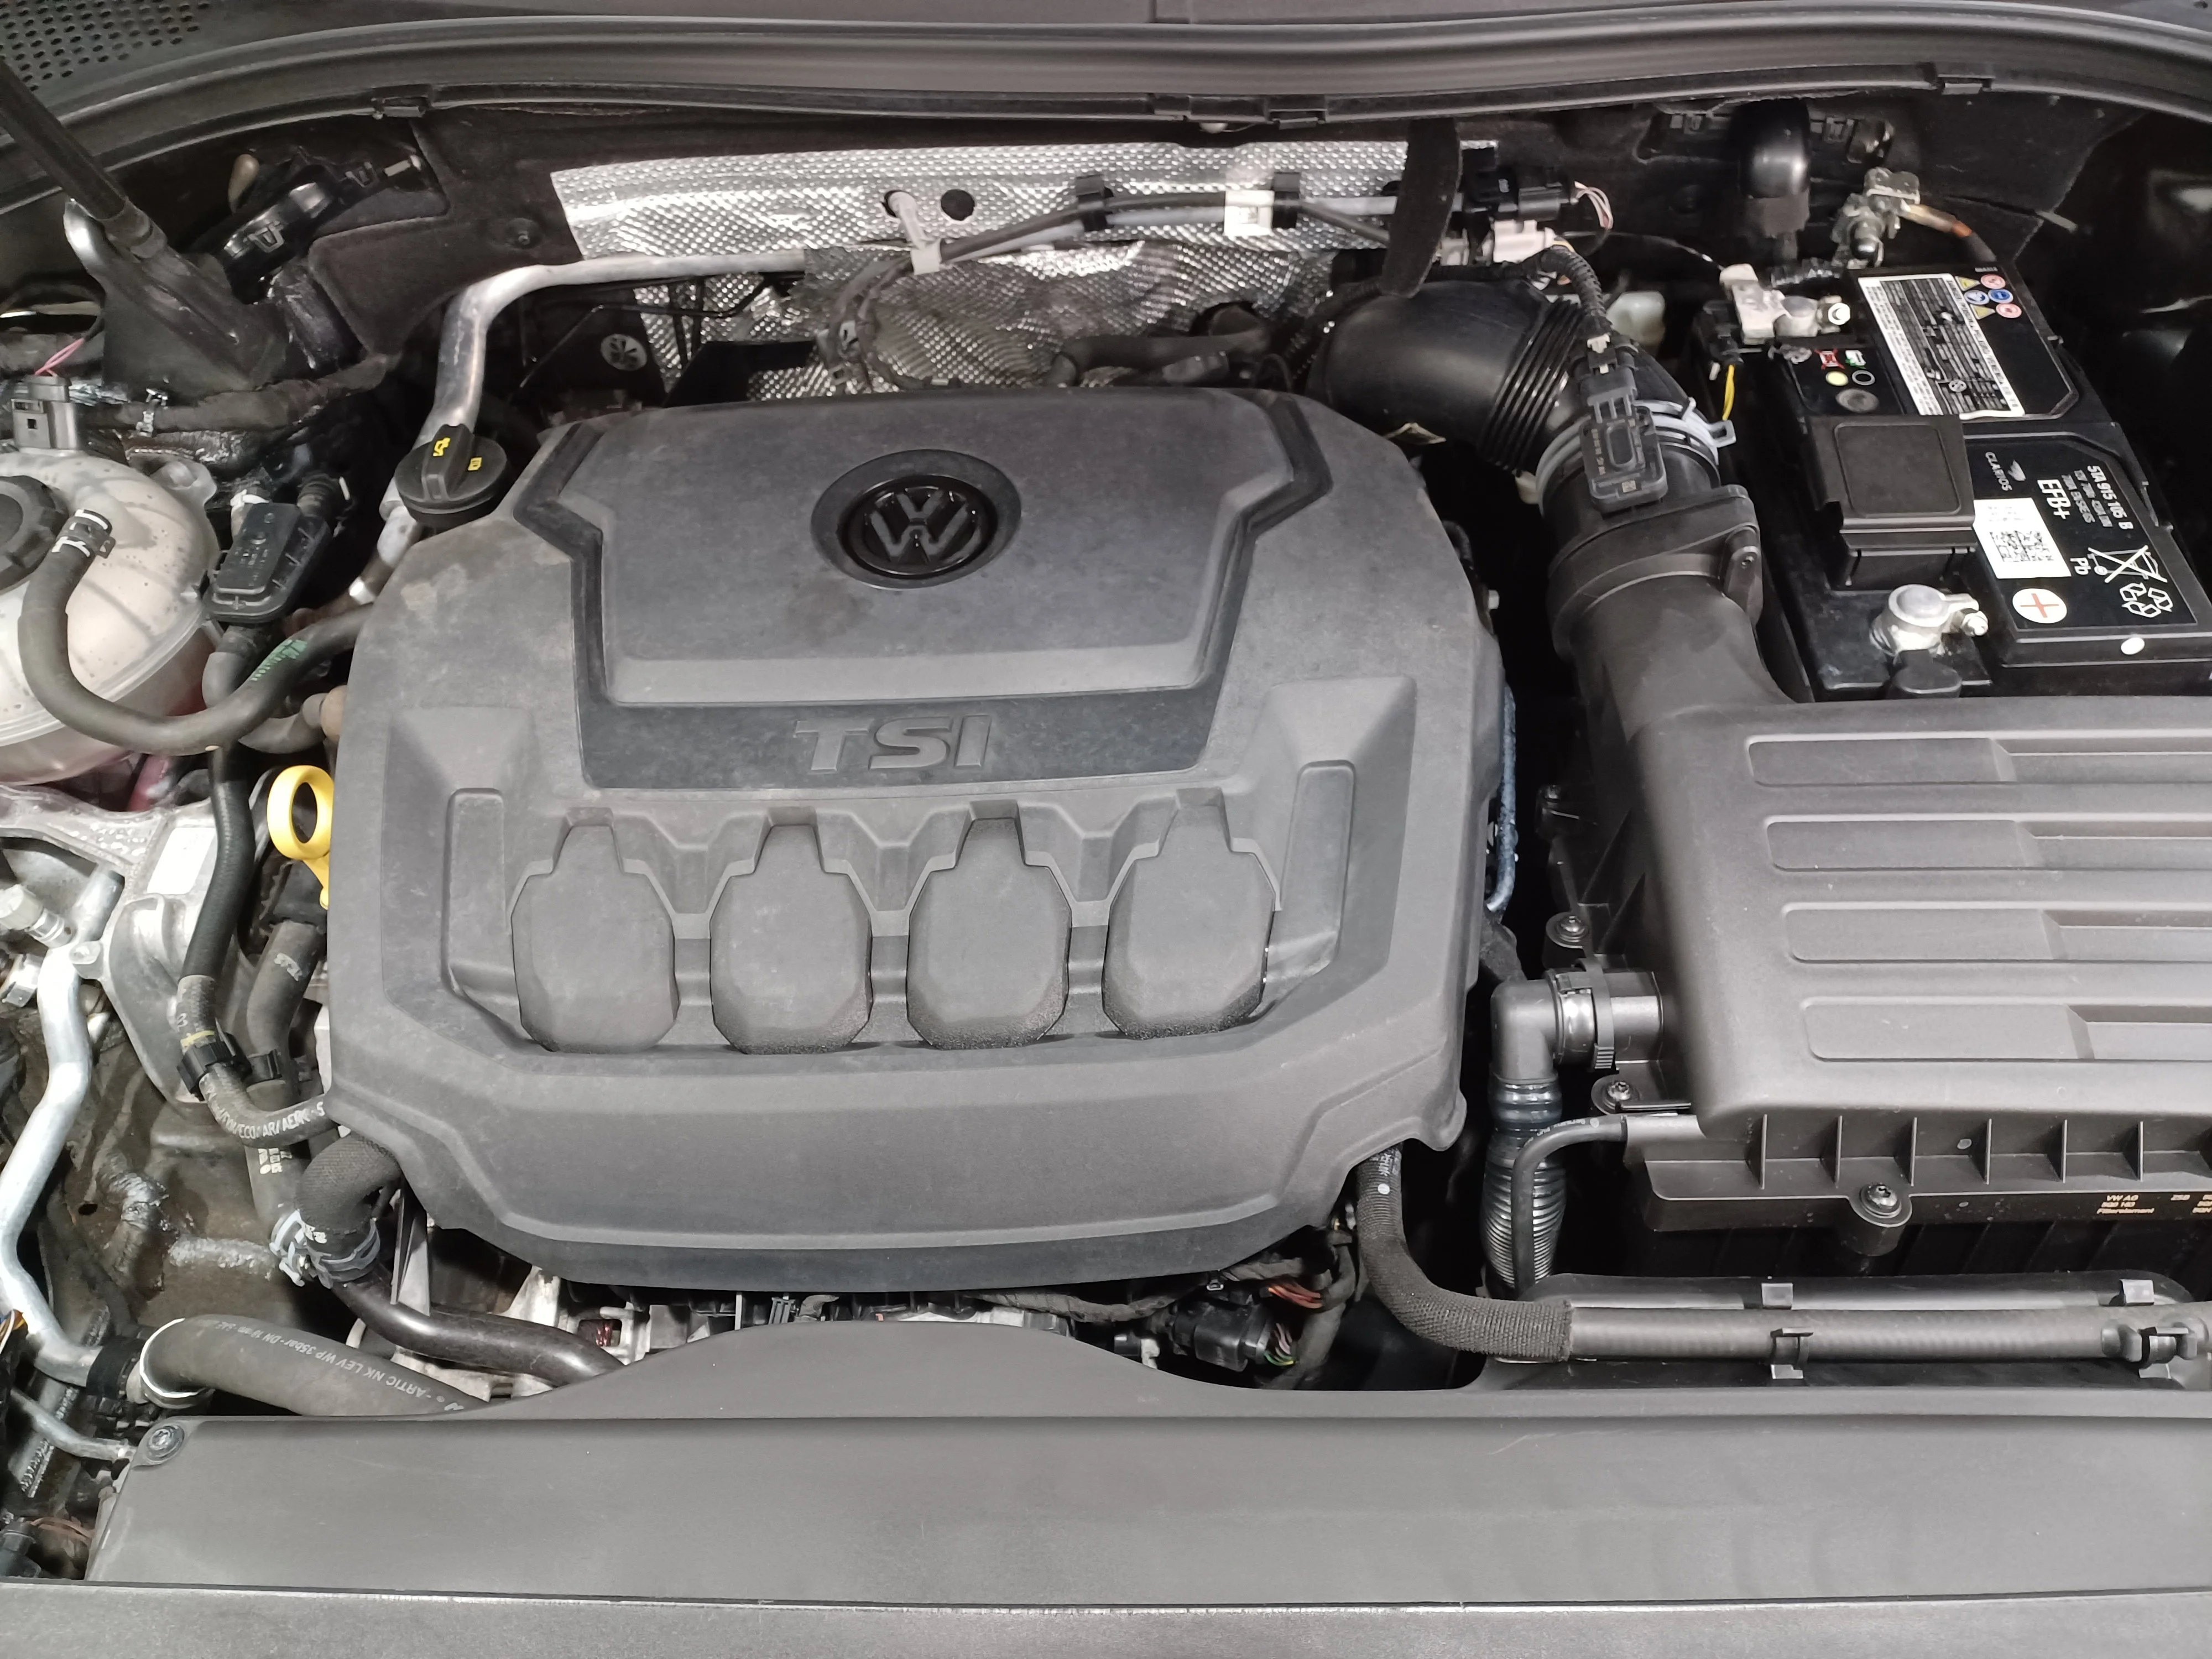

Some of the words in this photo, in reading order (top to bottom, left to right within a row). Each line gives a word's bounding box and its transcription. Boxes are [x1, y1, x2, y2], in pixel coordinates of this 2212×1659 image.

[1985, 452, 2012, 491] CLARIOS
[2088, 466, 2107, 483] 5TA
[2037, 479, 2071, 519] EFB+
[2097, 483, 2117, 500] 915
[2107, 500, 2128, 518] 105
[2070, 557, 2091, 575] Pb
[794, 714, 992, 774] TSI
[262, 1333, 281, 1344] DN
[315, 1351, 336, 1364] WP
[335, 1358, 363, 1374] LEV
[363, 1366, 386, 1381] NK
[385, 1376, 426, 1398] ARTIC
